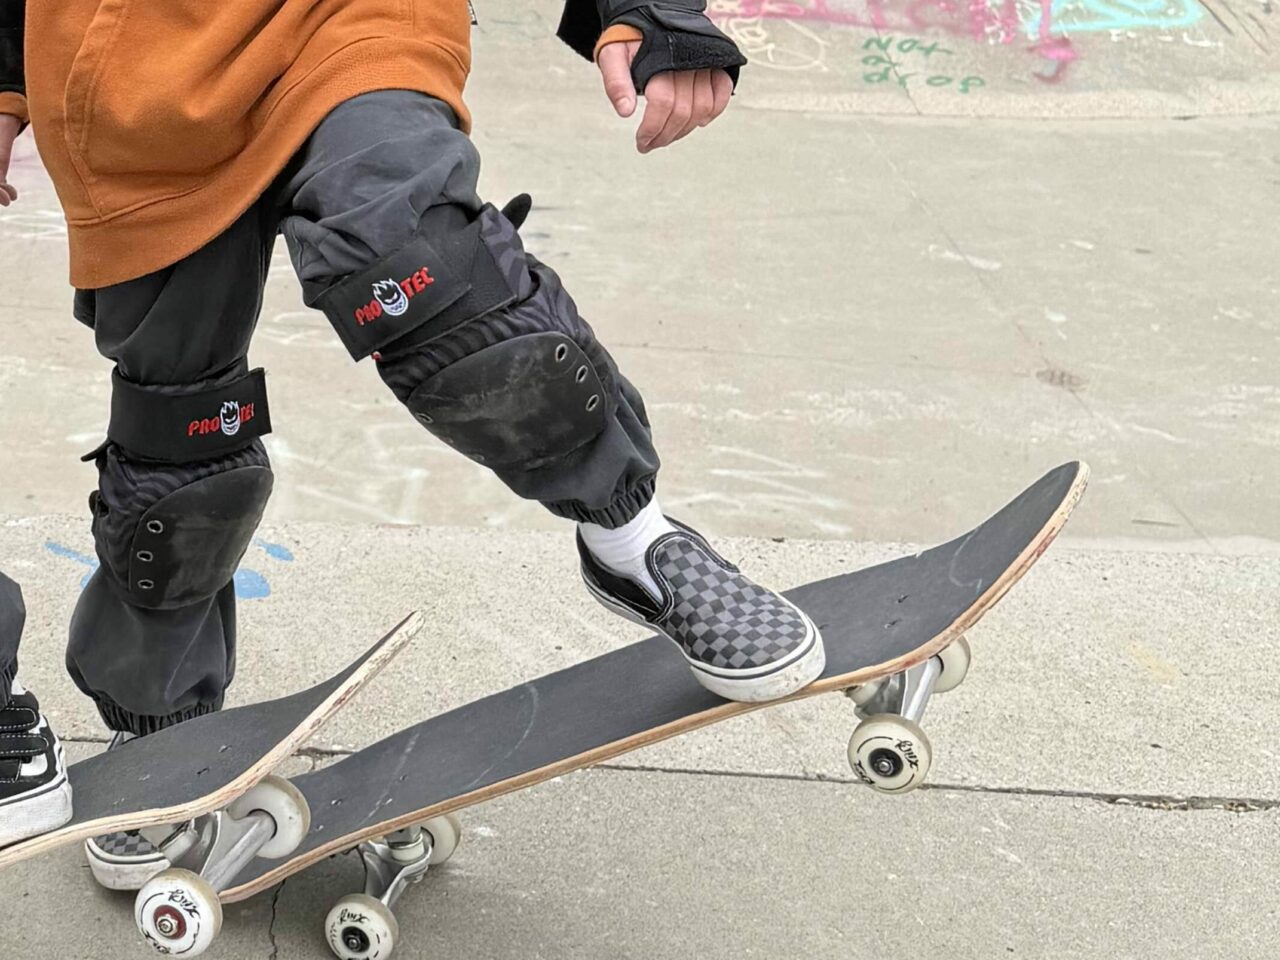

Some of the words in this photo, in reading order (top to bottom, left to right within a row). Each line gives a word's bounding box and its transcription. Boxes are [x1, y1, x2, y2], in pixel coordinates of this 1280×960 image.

[354, 300, 382, 326] PRO
[400, 266, 435, 298] TEC
[188, 416, 220, 436] PRO
